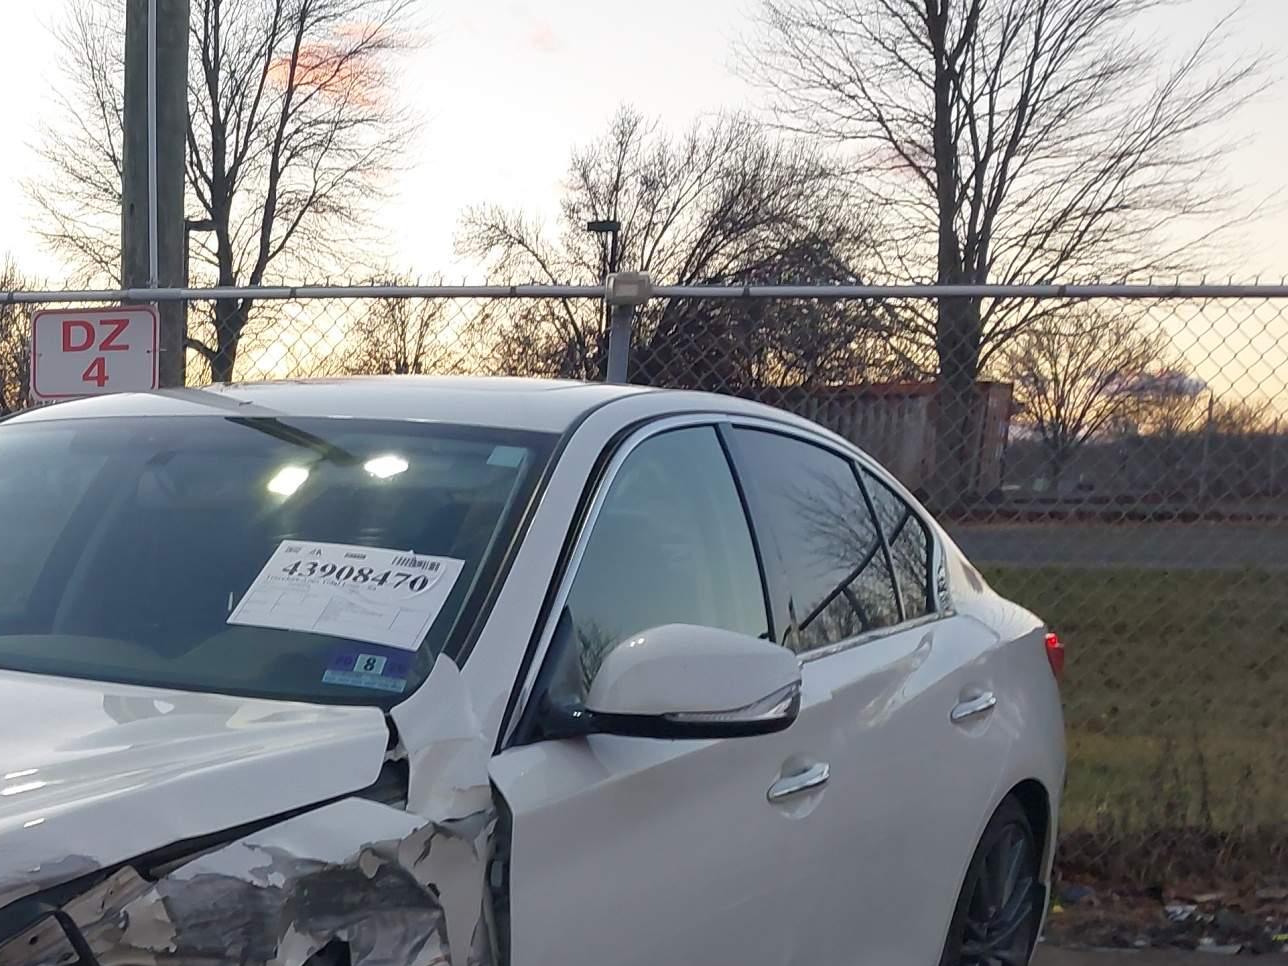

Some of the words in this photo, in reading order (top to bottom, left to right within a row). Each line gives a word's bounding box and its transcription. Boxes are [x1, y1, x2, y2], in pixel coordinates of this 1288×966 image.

[62, 319, 130, 352] DZ
[82, 357, 109, 387] 4
[282, 560, 429, 592] 43908470
[363, 657, 376, 671] 8
